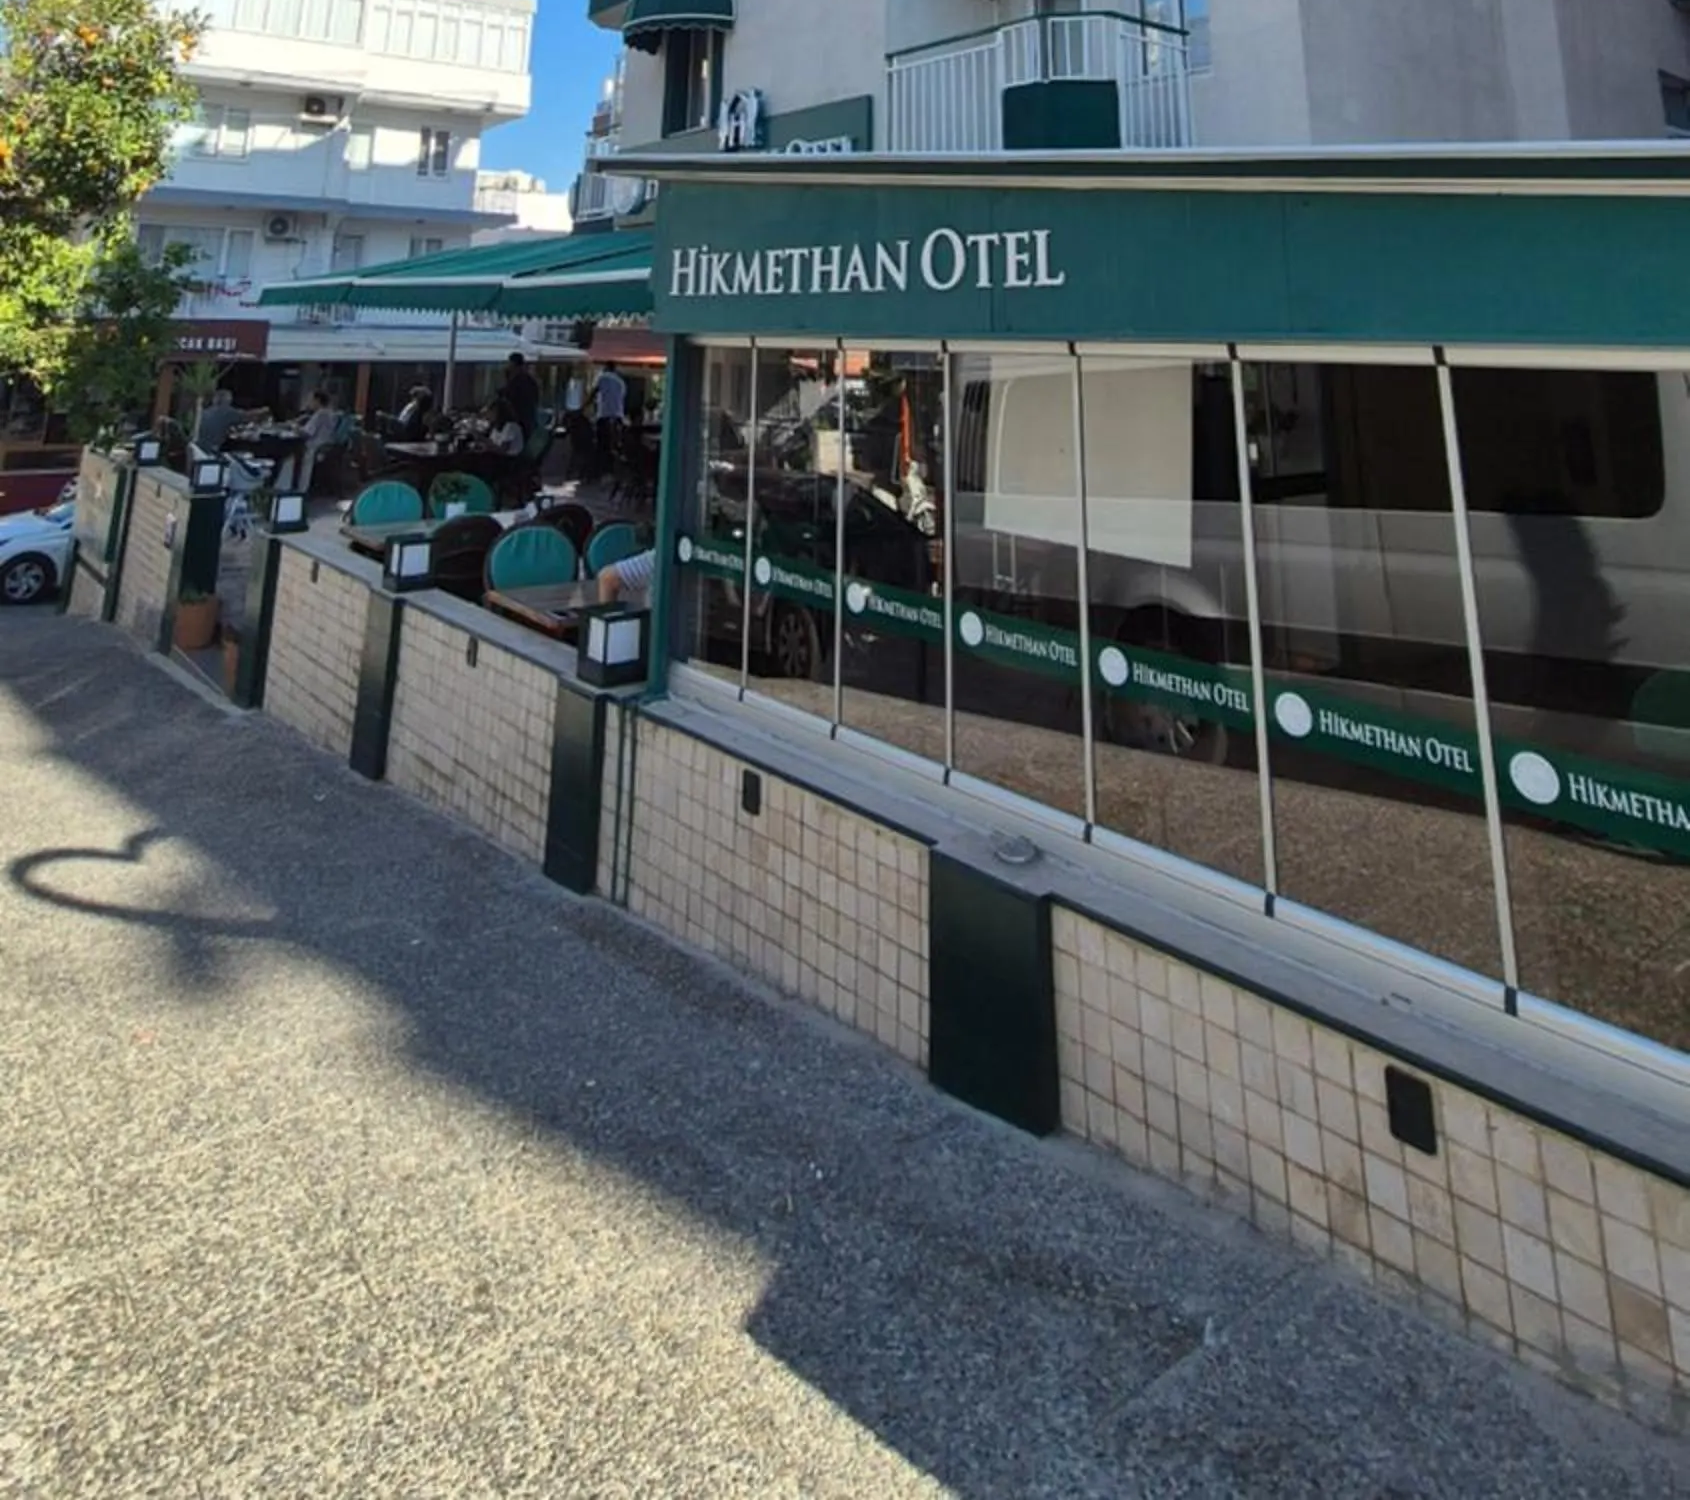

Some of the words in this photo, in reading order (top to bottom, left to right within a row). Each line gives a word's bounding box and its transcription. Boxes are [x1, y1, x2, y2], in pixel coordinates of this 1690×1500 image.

[920, 227, 1066, 291] OTEL
[1213, 682, 1250, 713] OTEL
[1425, 737, 1474, 773] OTEL
